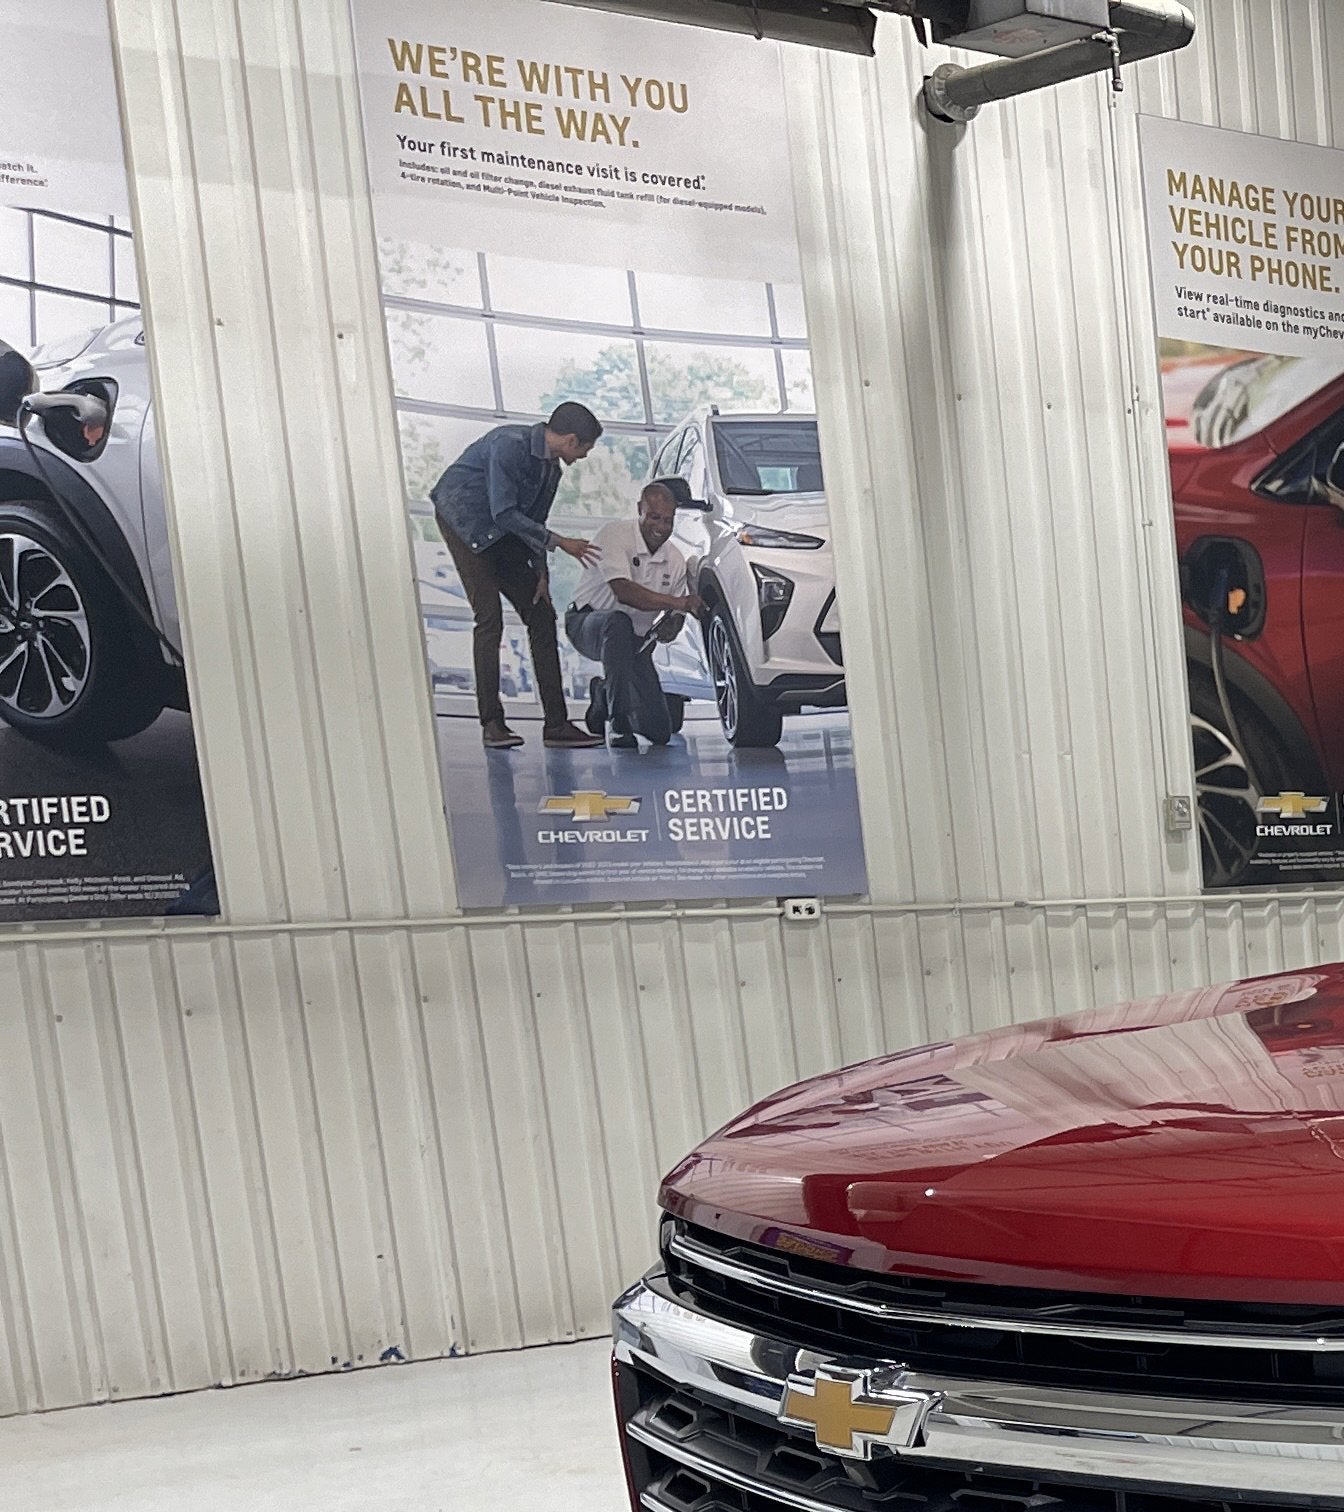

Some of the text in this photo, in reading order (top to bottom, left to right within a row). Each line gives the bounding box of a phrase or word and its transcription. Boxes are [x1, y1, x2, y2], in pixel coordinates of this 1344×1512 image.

[387, 38, 689, 114] WE'RE WITH YOU
[394, 82, 640, 148] ALL THE WAY.
[396, 134, 435, 154] Your
[440, 141, 477, 161] first
[481, 151, 583, 176] maintenance
[587, 163, 621, 181] visit
[624, 166, 637, 182] is
[452, 169, 467, 178] and
[466, 183, 481, 192] and
[1166, 168, 1277, 215] MANAGE
[1168, 205, 1278, 250] VEHICLE
[1171, 240, 1341, 294] YOUR PHONE.
[1174, 285, 1203, 302] View
[1206, 293, 1260, 311] real-time
[1262, 300, 1326, 320] diagnostics
[1212, 312, 1263, 329] available
[1265, 320, 1279, 331] on
[1281, 320, 1300, 334] the
[663, 787, 789, 813] CERTIFIED
[537, 829, 649, 844] CHEVROLET
[667, 815, 772, 842] SERVICE
[1255, 824, 1333, 837] CHEVROLET
